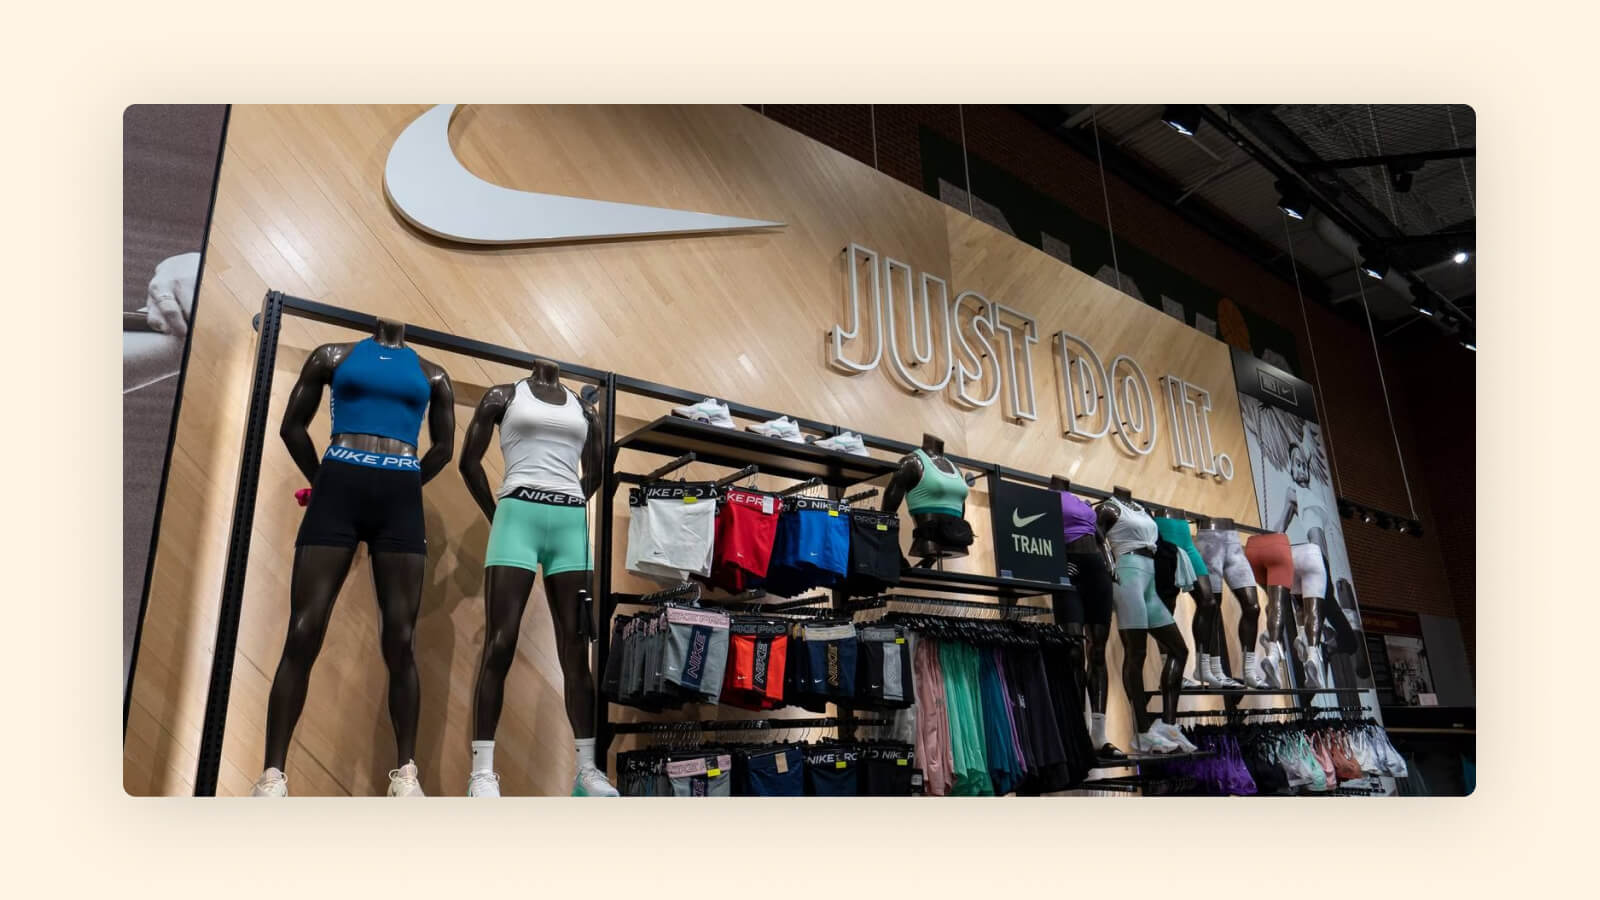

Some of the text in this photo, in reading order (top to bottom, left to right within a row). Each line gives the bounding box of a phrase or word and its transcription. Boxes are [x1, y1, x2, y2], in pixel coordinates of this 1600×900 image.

[832, 242, 1234, 481] JUST DO IT.
[325, 447, 380, 465] NIKE
[519, 489, 566, 504] NIKE
[1011, 533, 1053, 558] TRAIN
[687, 630, 706, 680] NIKE
[806, 753, 835, 765] NIKE
